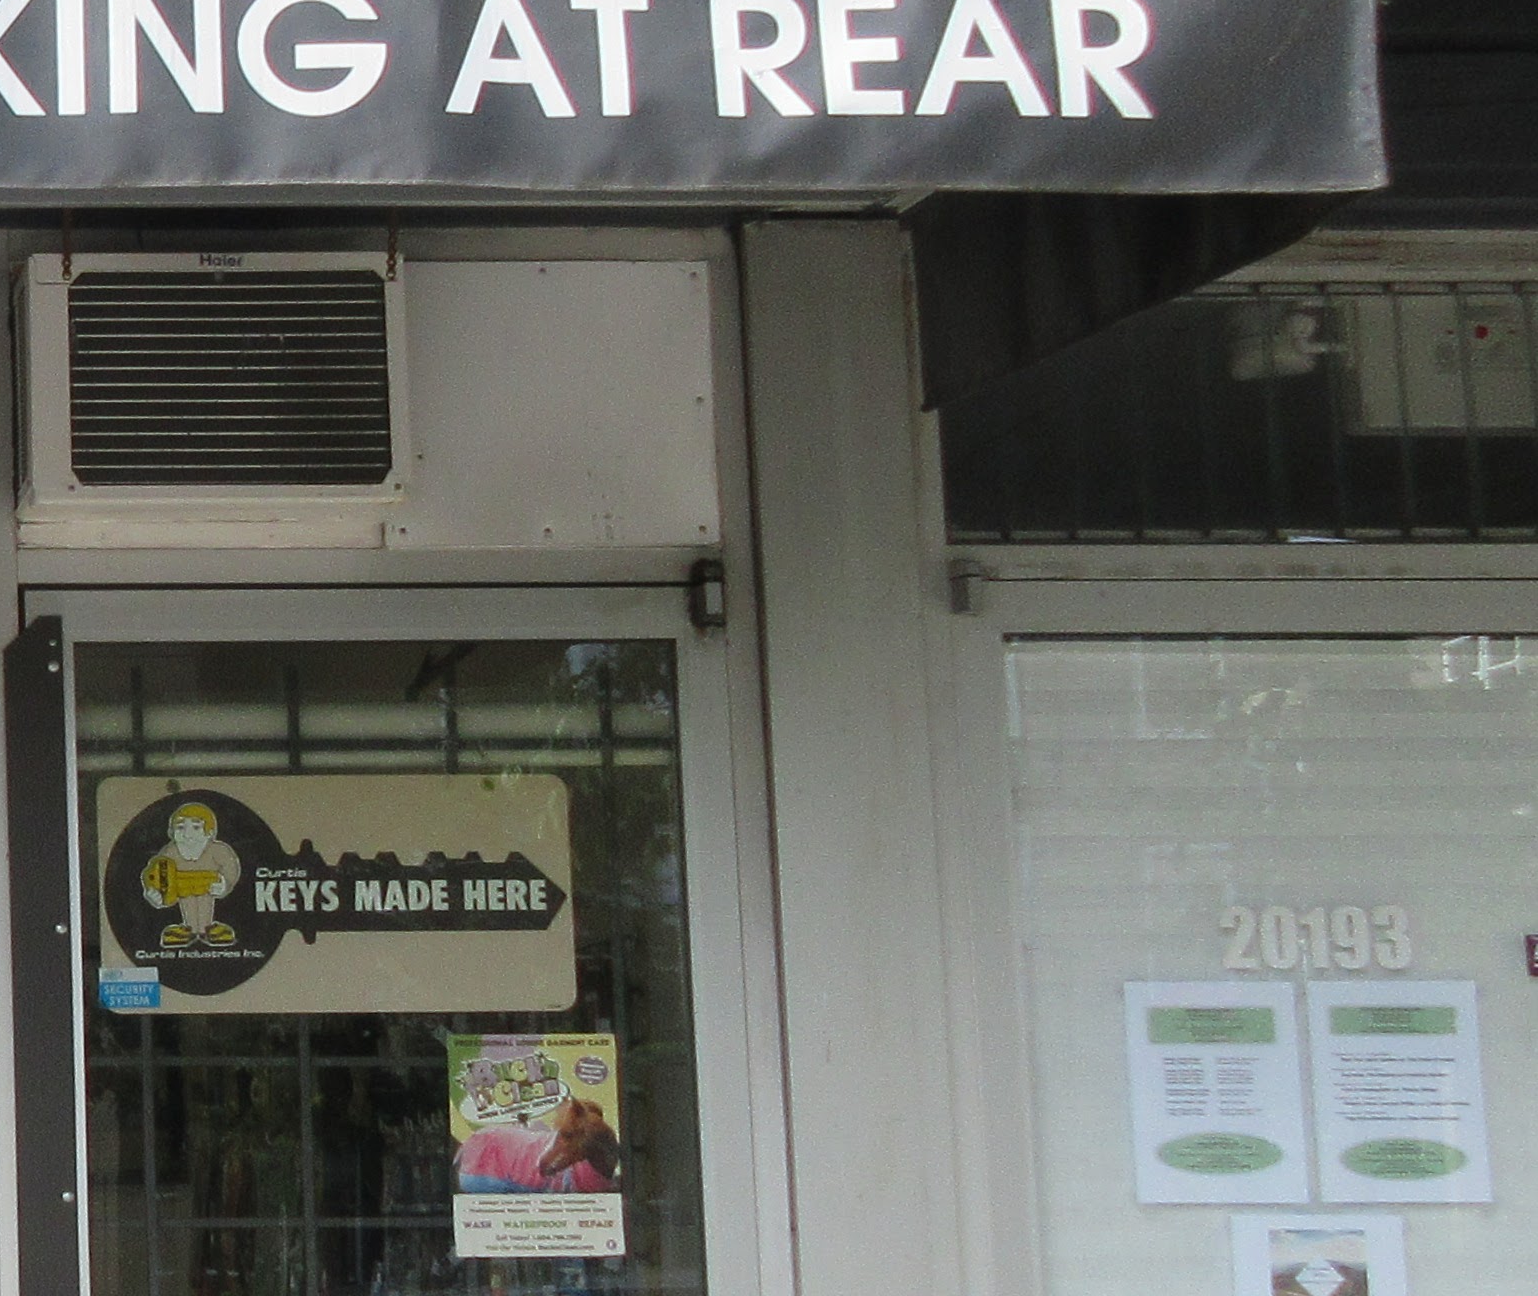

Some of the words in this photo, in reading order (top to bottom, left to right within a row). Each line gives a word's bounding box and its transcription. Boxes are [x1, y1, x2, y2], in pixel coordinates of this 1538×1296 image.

[200, 253, 243, 267] Haier
[256, 867, 307, 878] Curtis
[255, 880, 339, 912] KEYS
[355, 879, 449, 911] MADE
[463, 879, 547, 911] HERE
[1222, 906, 1411, 970] 20193
[104, 985, 153, 995] SECURITY
